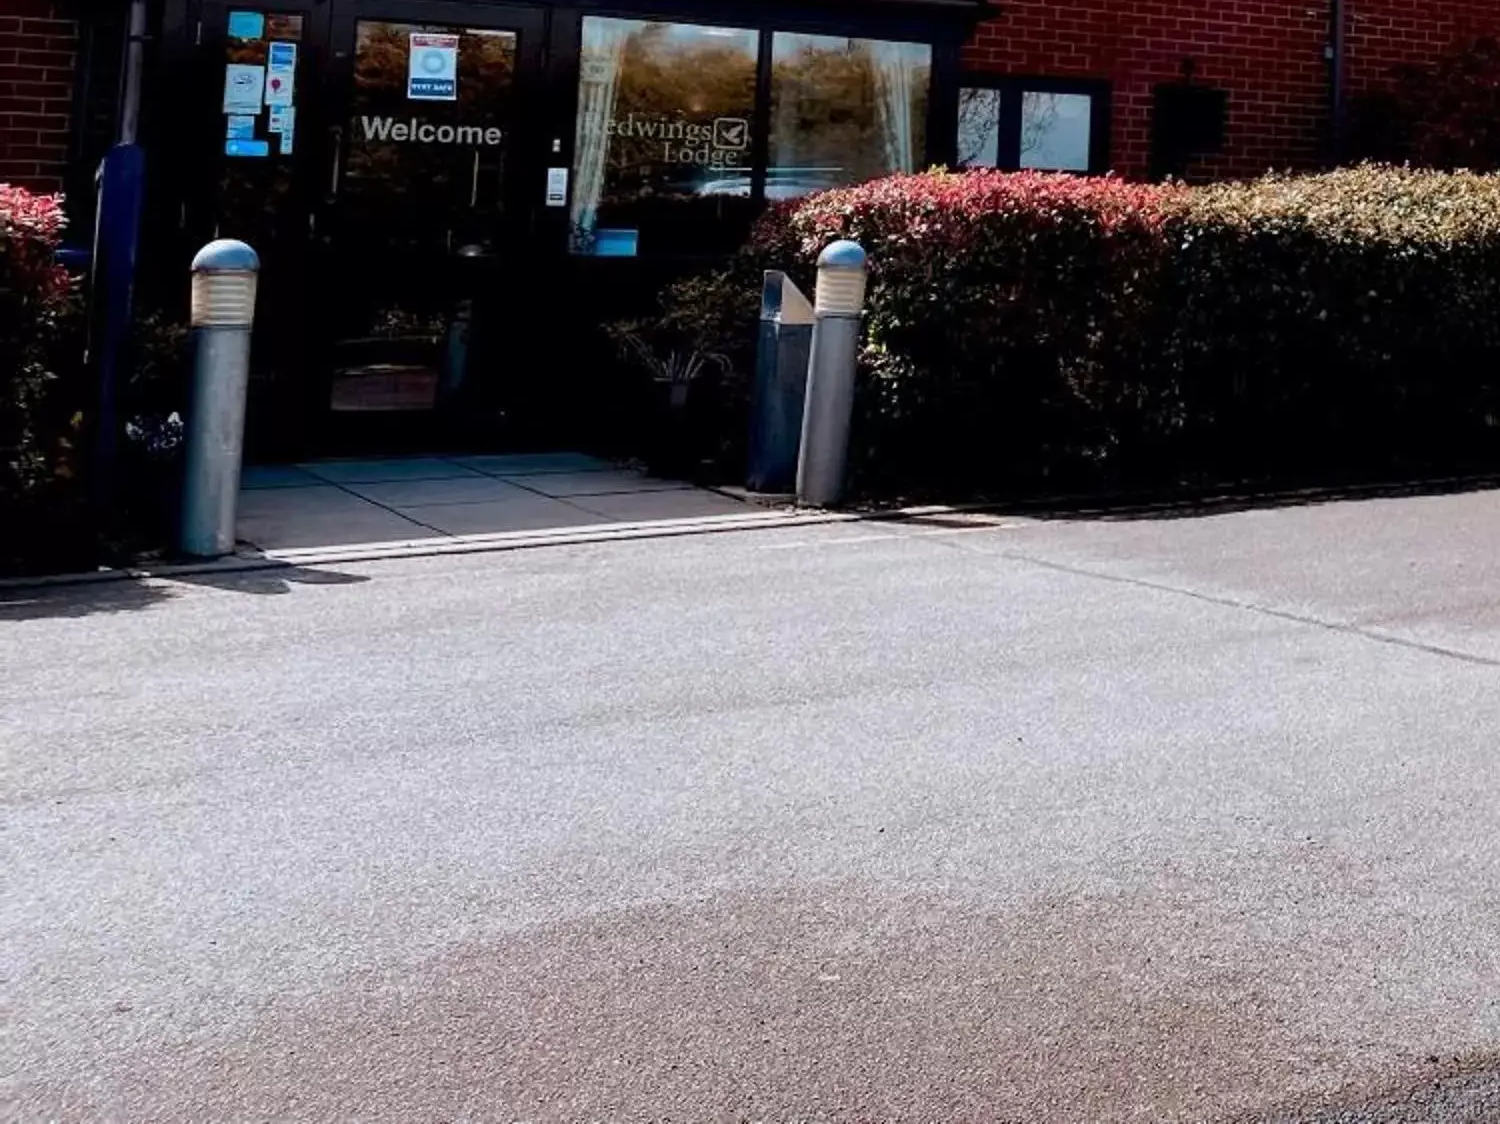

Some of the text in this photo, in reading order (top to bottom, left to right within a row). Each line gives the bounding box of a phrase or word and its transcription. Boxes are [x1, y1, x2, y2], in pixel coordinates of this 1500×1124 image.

[361, 115, 502, 145] Welcome
[586, 112, 713, 146] edwings
[663, 141, 738, 168] Lodge
